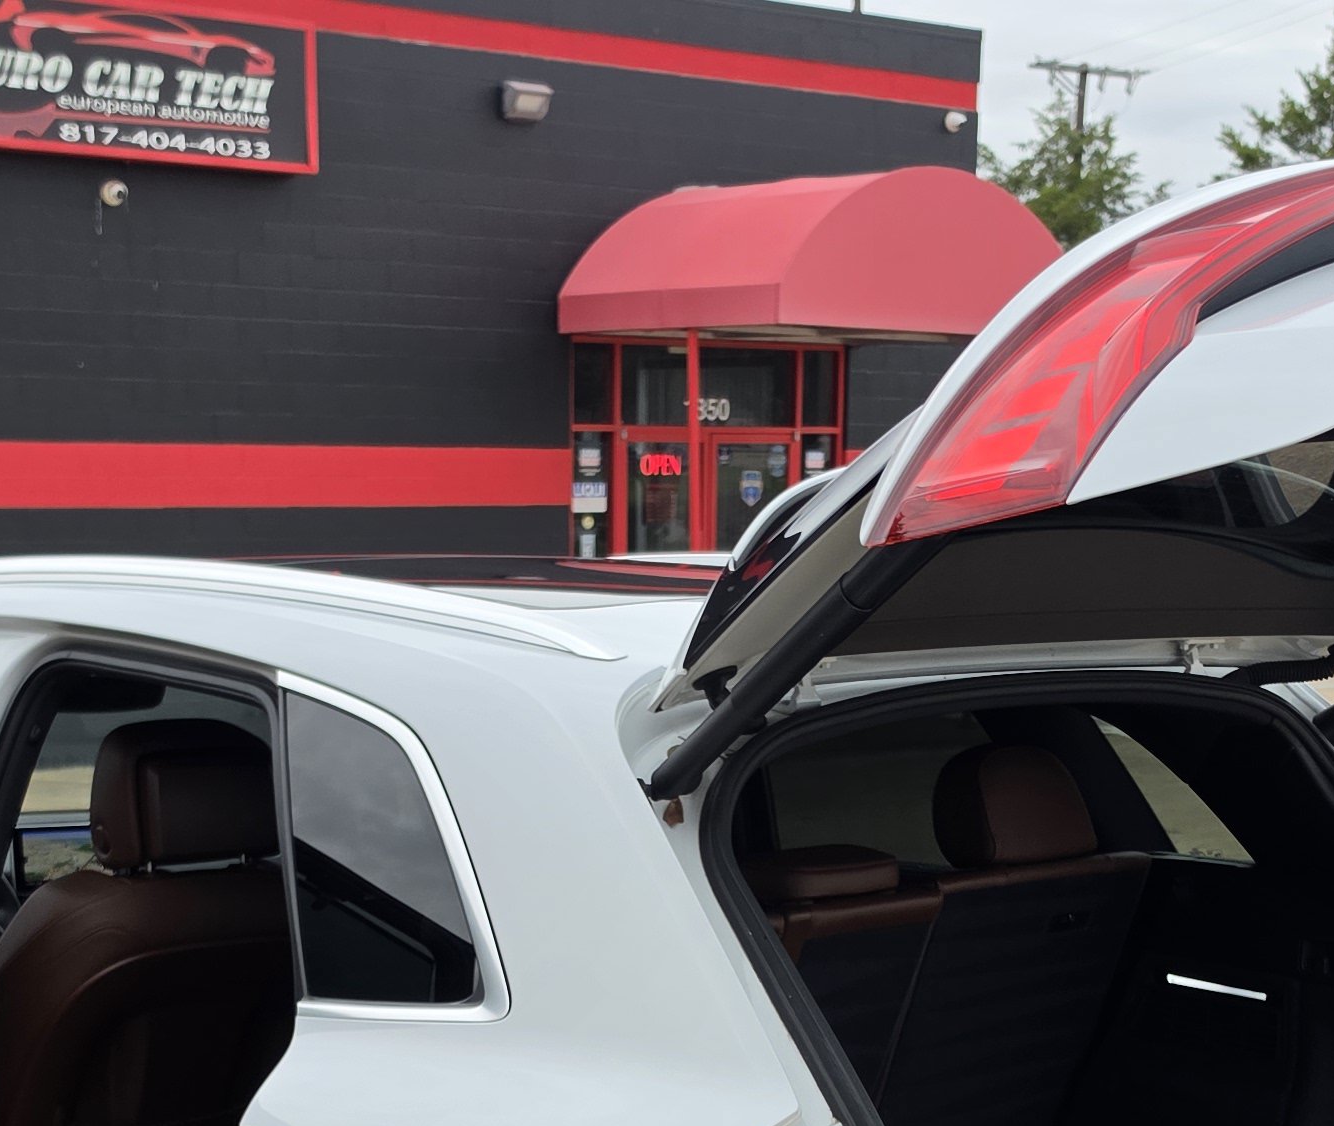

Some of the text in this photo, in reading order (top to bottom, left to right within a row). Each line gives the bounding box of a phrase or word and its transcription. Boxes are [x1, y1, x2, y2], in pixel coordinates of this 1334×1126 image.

[82, 59, 165, 103] CAR
[175, 69, 275, 114] TECH
[56, 94, 270, 129] european automotive
[58, 123, 271, 160] 817-404-4033
[683, 398, 731, 421] 350
[640, 454, 682, 476] OPEN
